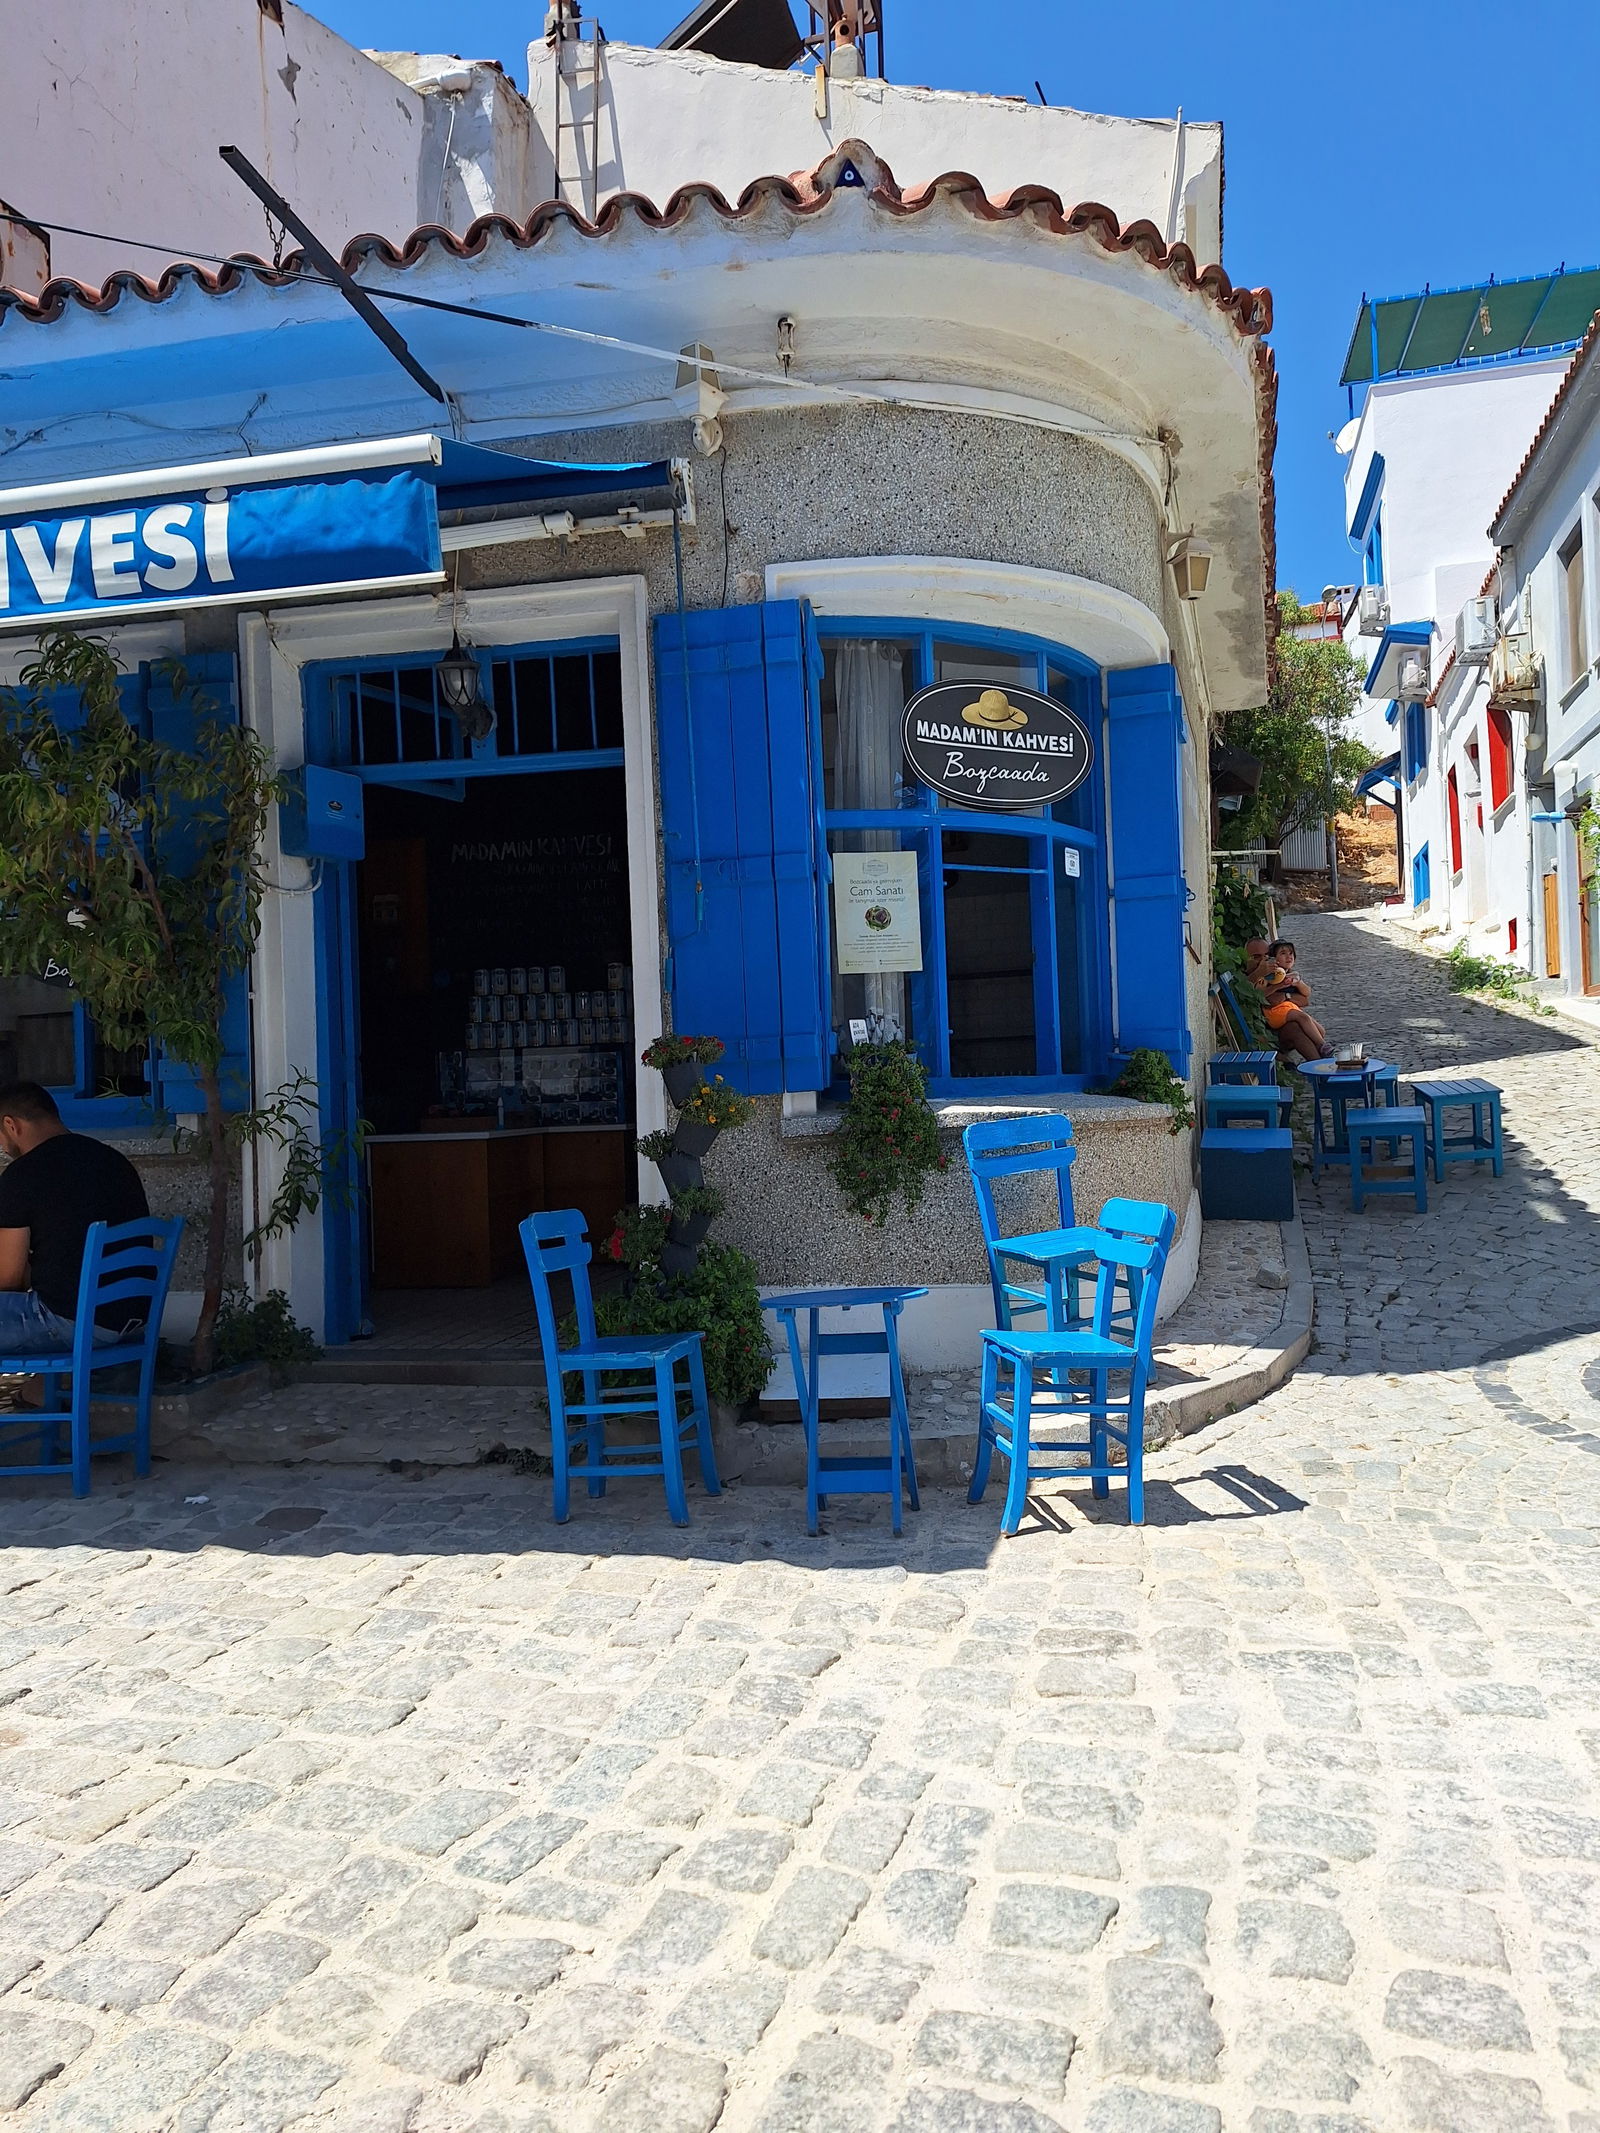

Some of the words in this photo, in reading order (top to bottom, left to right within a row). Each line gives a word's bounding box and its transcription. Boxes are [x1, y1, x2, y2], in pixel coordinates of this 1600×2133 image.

[0, 487, 235, 609] VESİ
[916, 719, 998, 746] MADAM'IN
[1003, 730, 1074, 753] KAHVESİ
[942, 751, 1050, 793] Bozcaada
[849, 886, 873, 897] Cam
[875, 885, 904, 896] Sanatı
